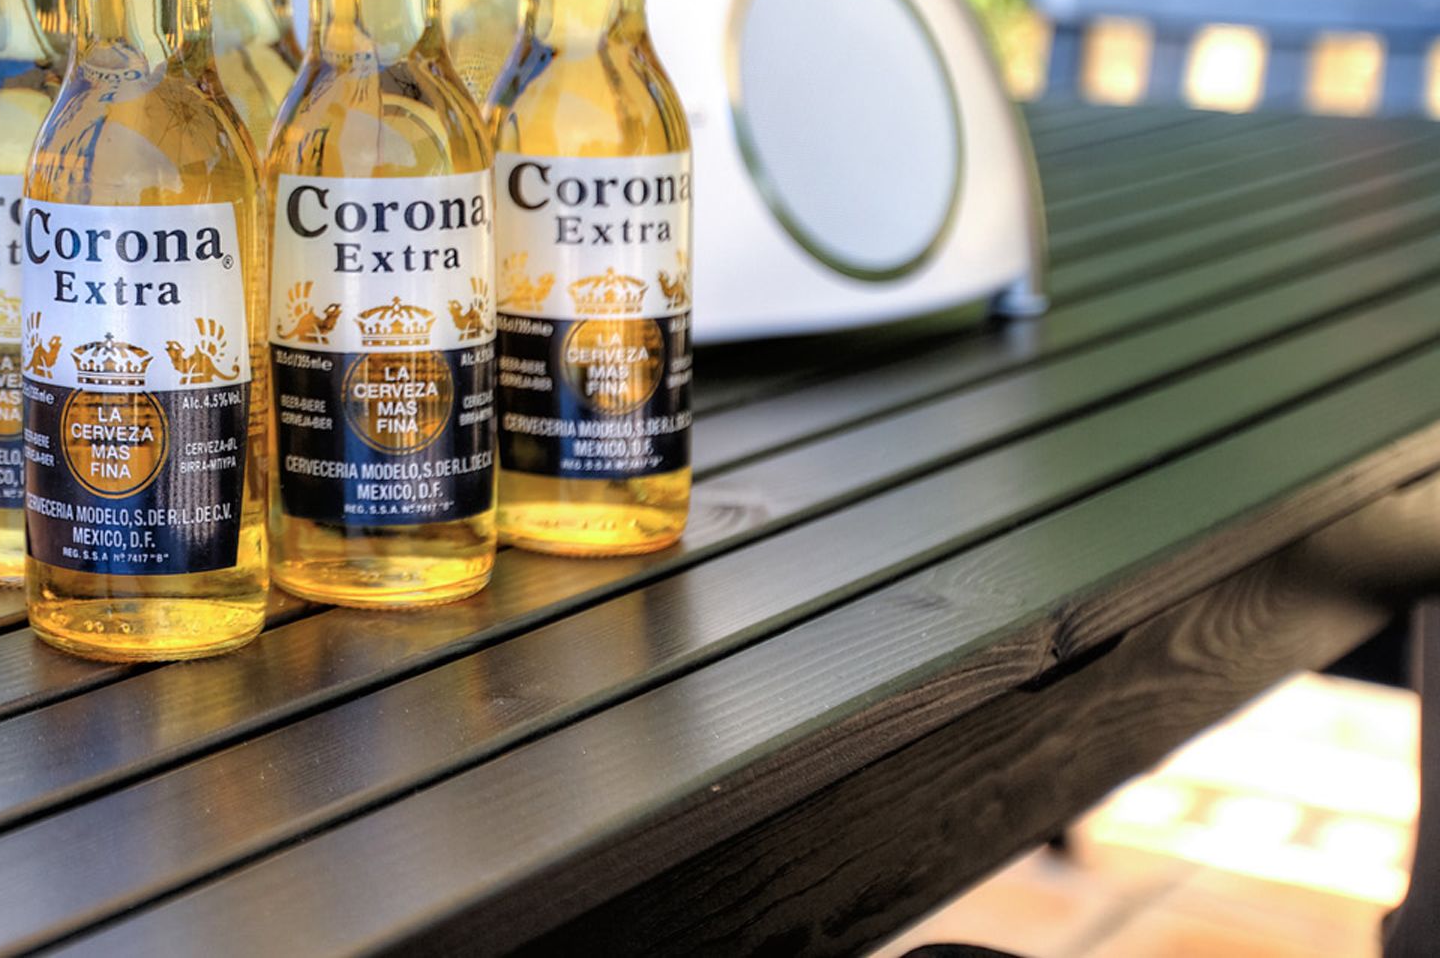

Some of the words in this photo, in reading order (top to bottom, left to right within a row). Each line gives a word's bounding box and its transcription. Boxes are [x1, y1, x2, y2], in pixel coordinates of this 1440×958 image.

[508, 162, 691, 210] Corona
[287, 185, 486, 238] Corona
[25, 207, 224, 264] Corona
[555, 215, 671, 245] Extra
[334, 242, 460, 273] Extra
[54, 270, 181, 306] Extra
[597, 332, 622, 346] LA
[567, 346, 649, 364] CERVEZA
[385, 365, 410, 381] LA
[588, 364, 629, 381] MAS
[353, 382, 439, 399] CERVEZA
[586, 381, 628, 396] FINA
[98, 407, 122, 422] LA
[377, 400, 418, 416] MAS
[71, 423, 154, 442] CERVEZA
[376, 418, 418, 434] FINA
[91, 444, 131, 460] MAS
[90, 462, 131, 479] FINA
[285, 454, 359, 479] CERVECERIA
[361, 462, 422, 481] MODELO,
[357, 483, 417, 502] MEXICO,
[419, 482, 443, 499] D.F.
[76, 505, 132, 528] MODELO,
[73, 526, 127, 550] MEXICO,
[130, 531, 156, 548] D.F.
[63, 547, 82, 559] REG.
[127, 553, 148, 563] 7417
